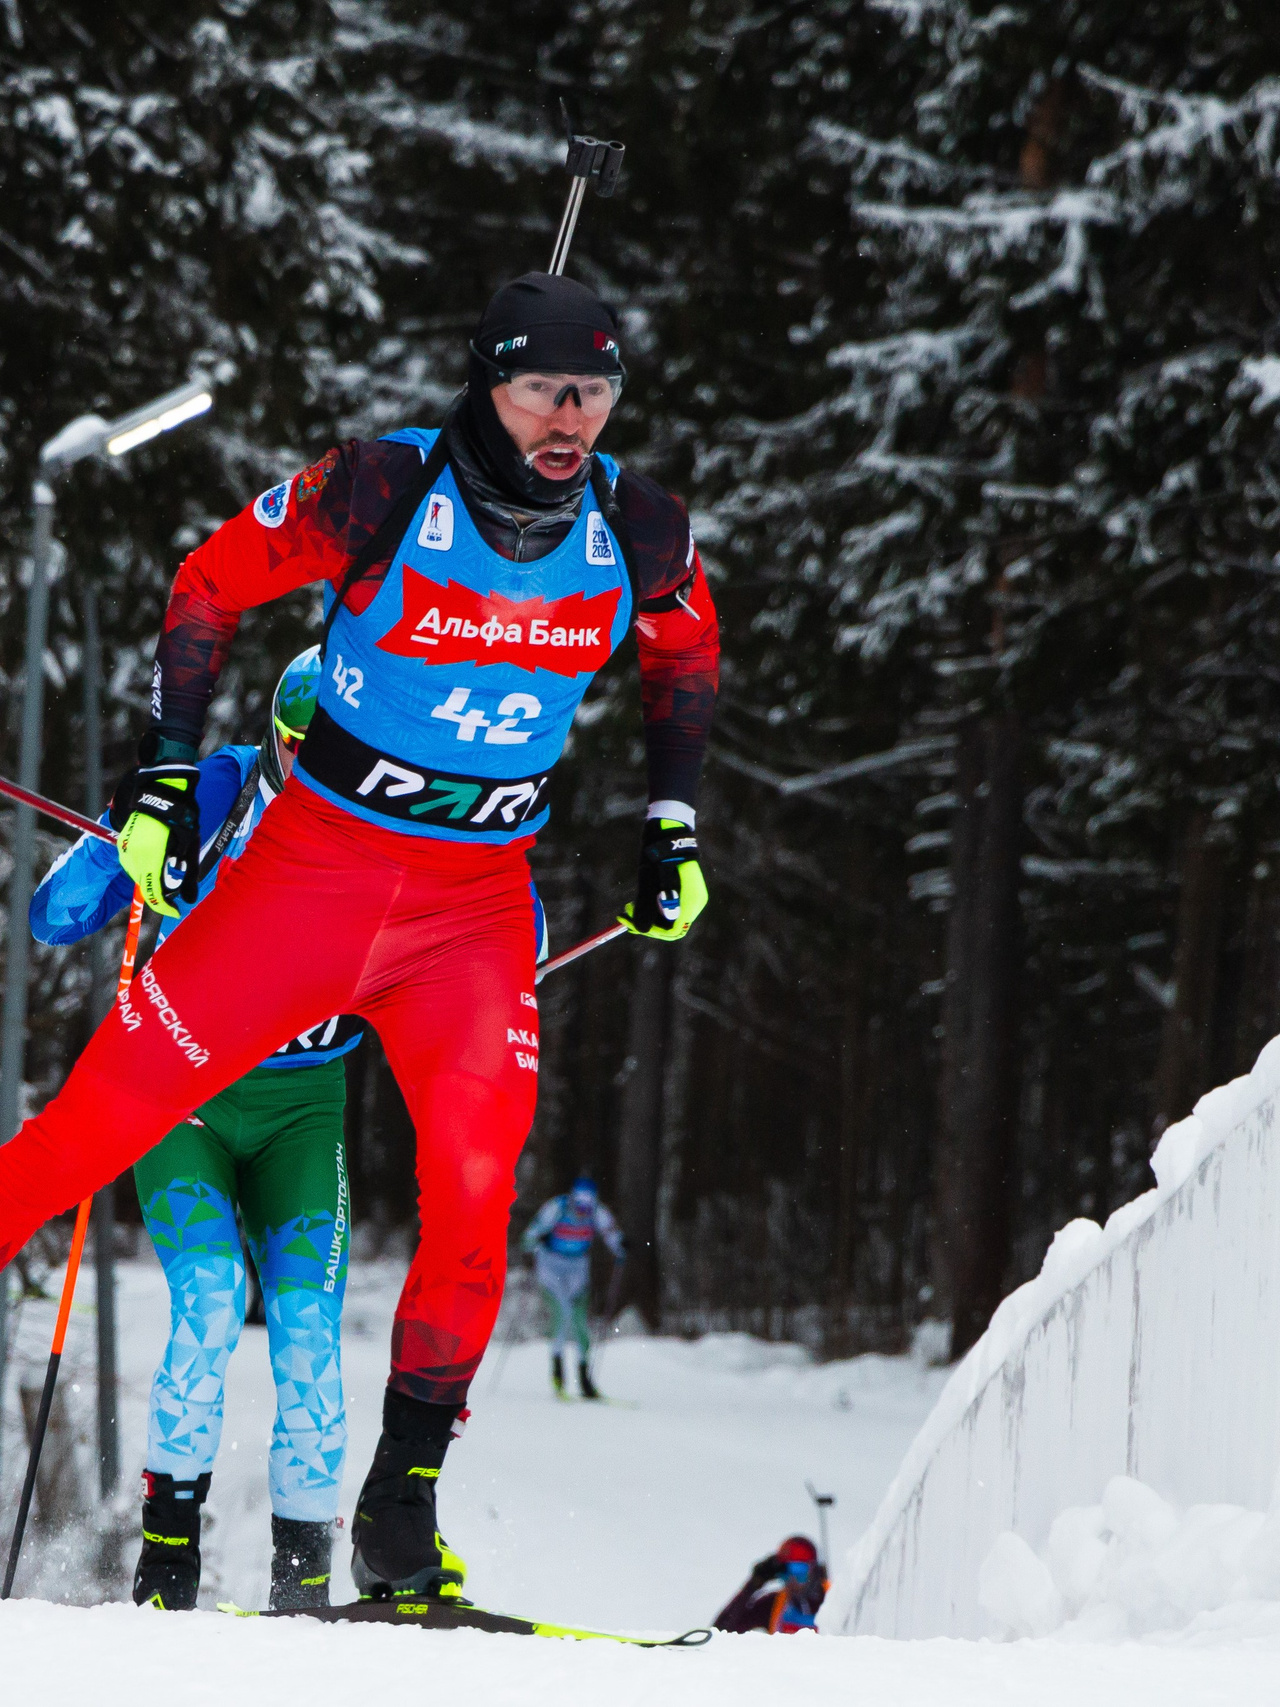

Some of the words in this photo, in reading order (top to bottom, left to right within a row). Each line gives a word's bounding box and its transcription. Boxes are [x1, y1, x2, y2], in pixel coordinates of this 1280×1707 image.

[495, 335, 527, 356] PARI
[411, 607, 522, 647] Альфа
[529, 619, 601, 647] Банк
[332, 654, 364, 709] 42
[431, 687, 542, 744] 42
[356, 759, 548, 823] PARI
[141, 957, 210, 1068] НОЯРСКИЙ
[507, 1028, 538, 1050] АКА
[323, 1142, 347, 1293] БАШКОРТОСТАН
[396, 1604, 428, 1614] FISCHER
